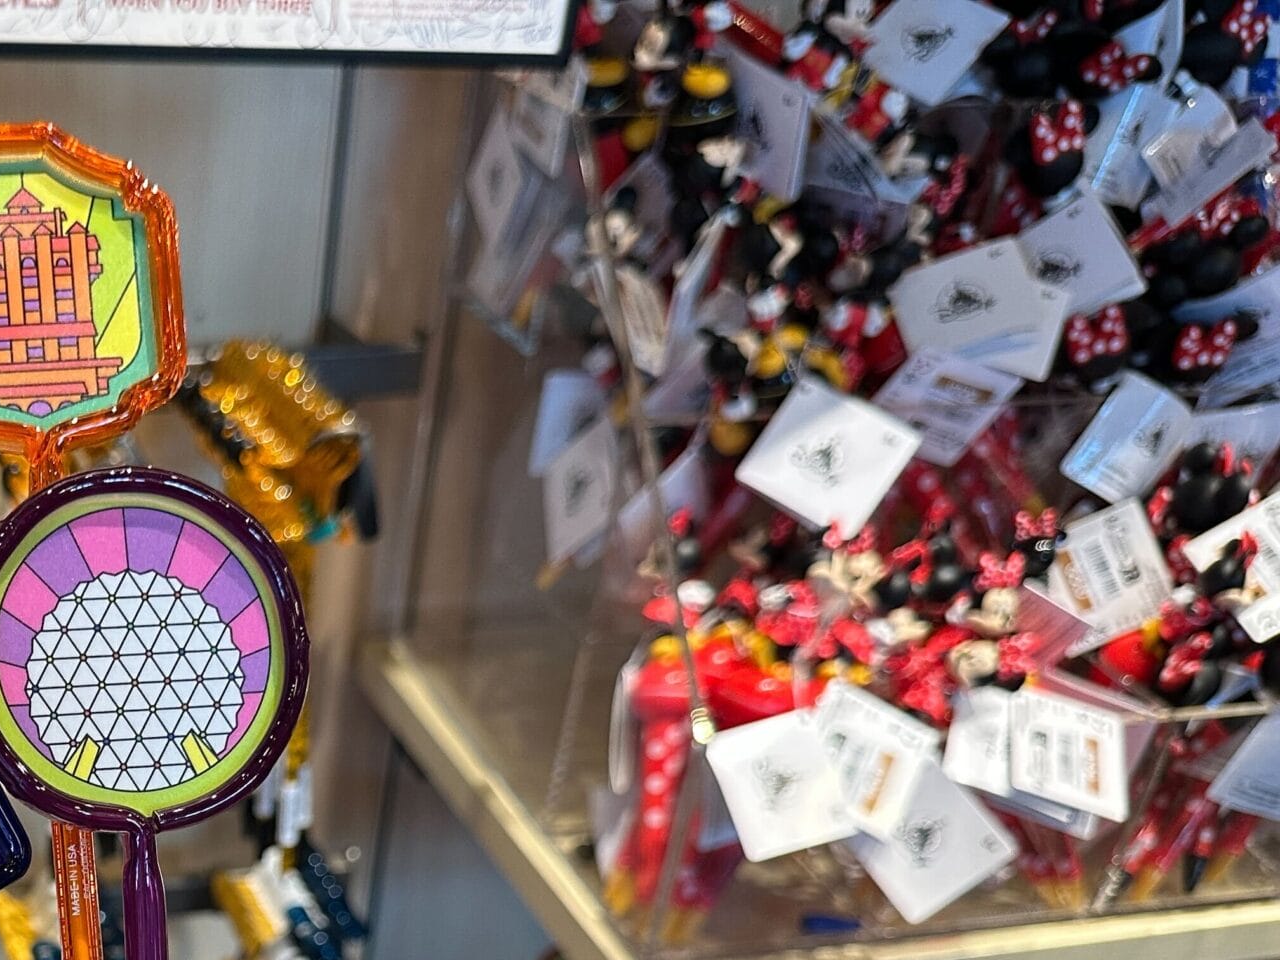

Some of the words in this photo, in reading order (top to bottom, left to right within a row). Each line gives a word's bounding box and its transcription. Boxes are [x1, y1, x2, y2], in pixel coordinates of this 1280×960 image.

[67, 844, 77, 867] USA
[69, 870, 78, 880] IN
[70, 883, 81, 915] MADE
